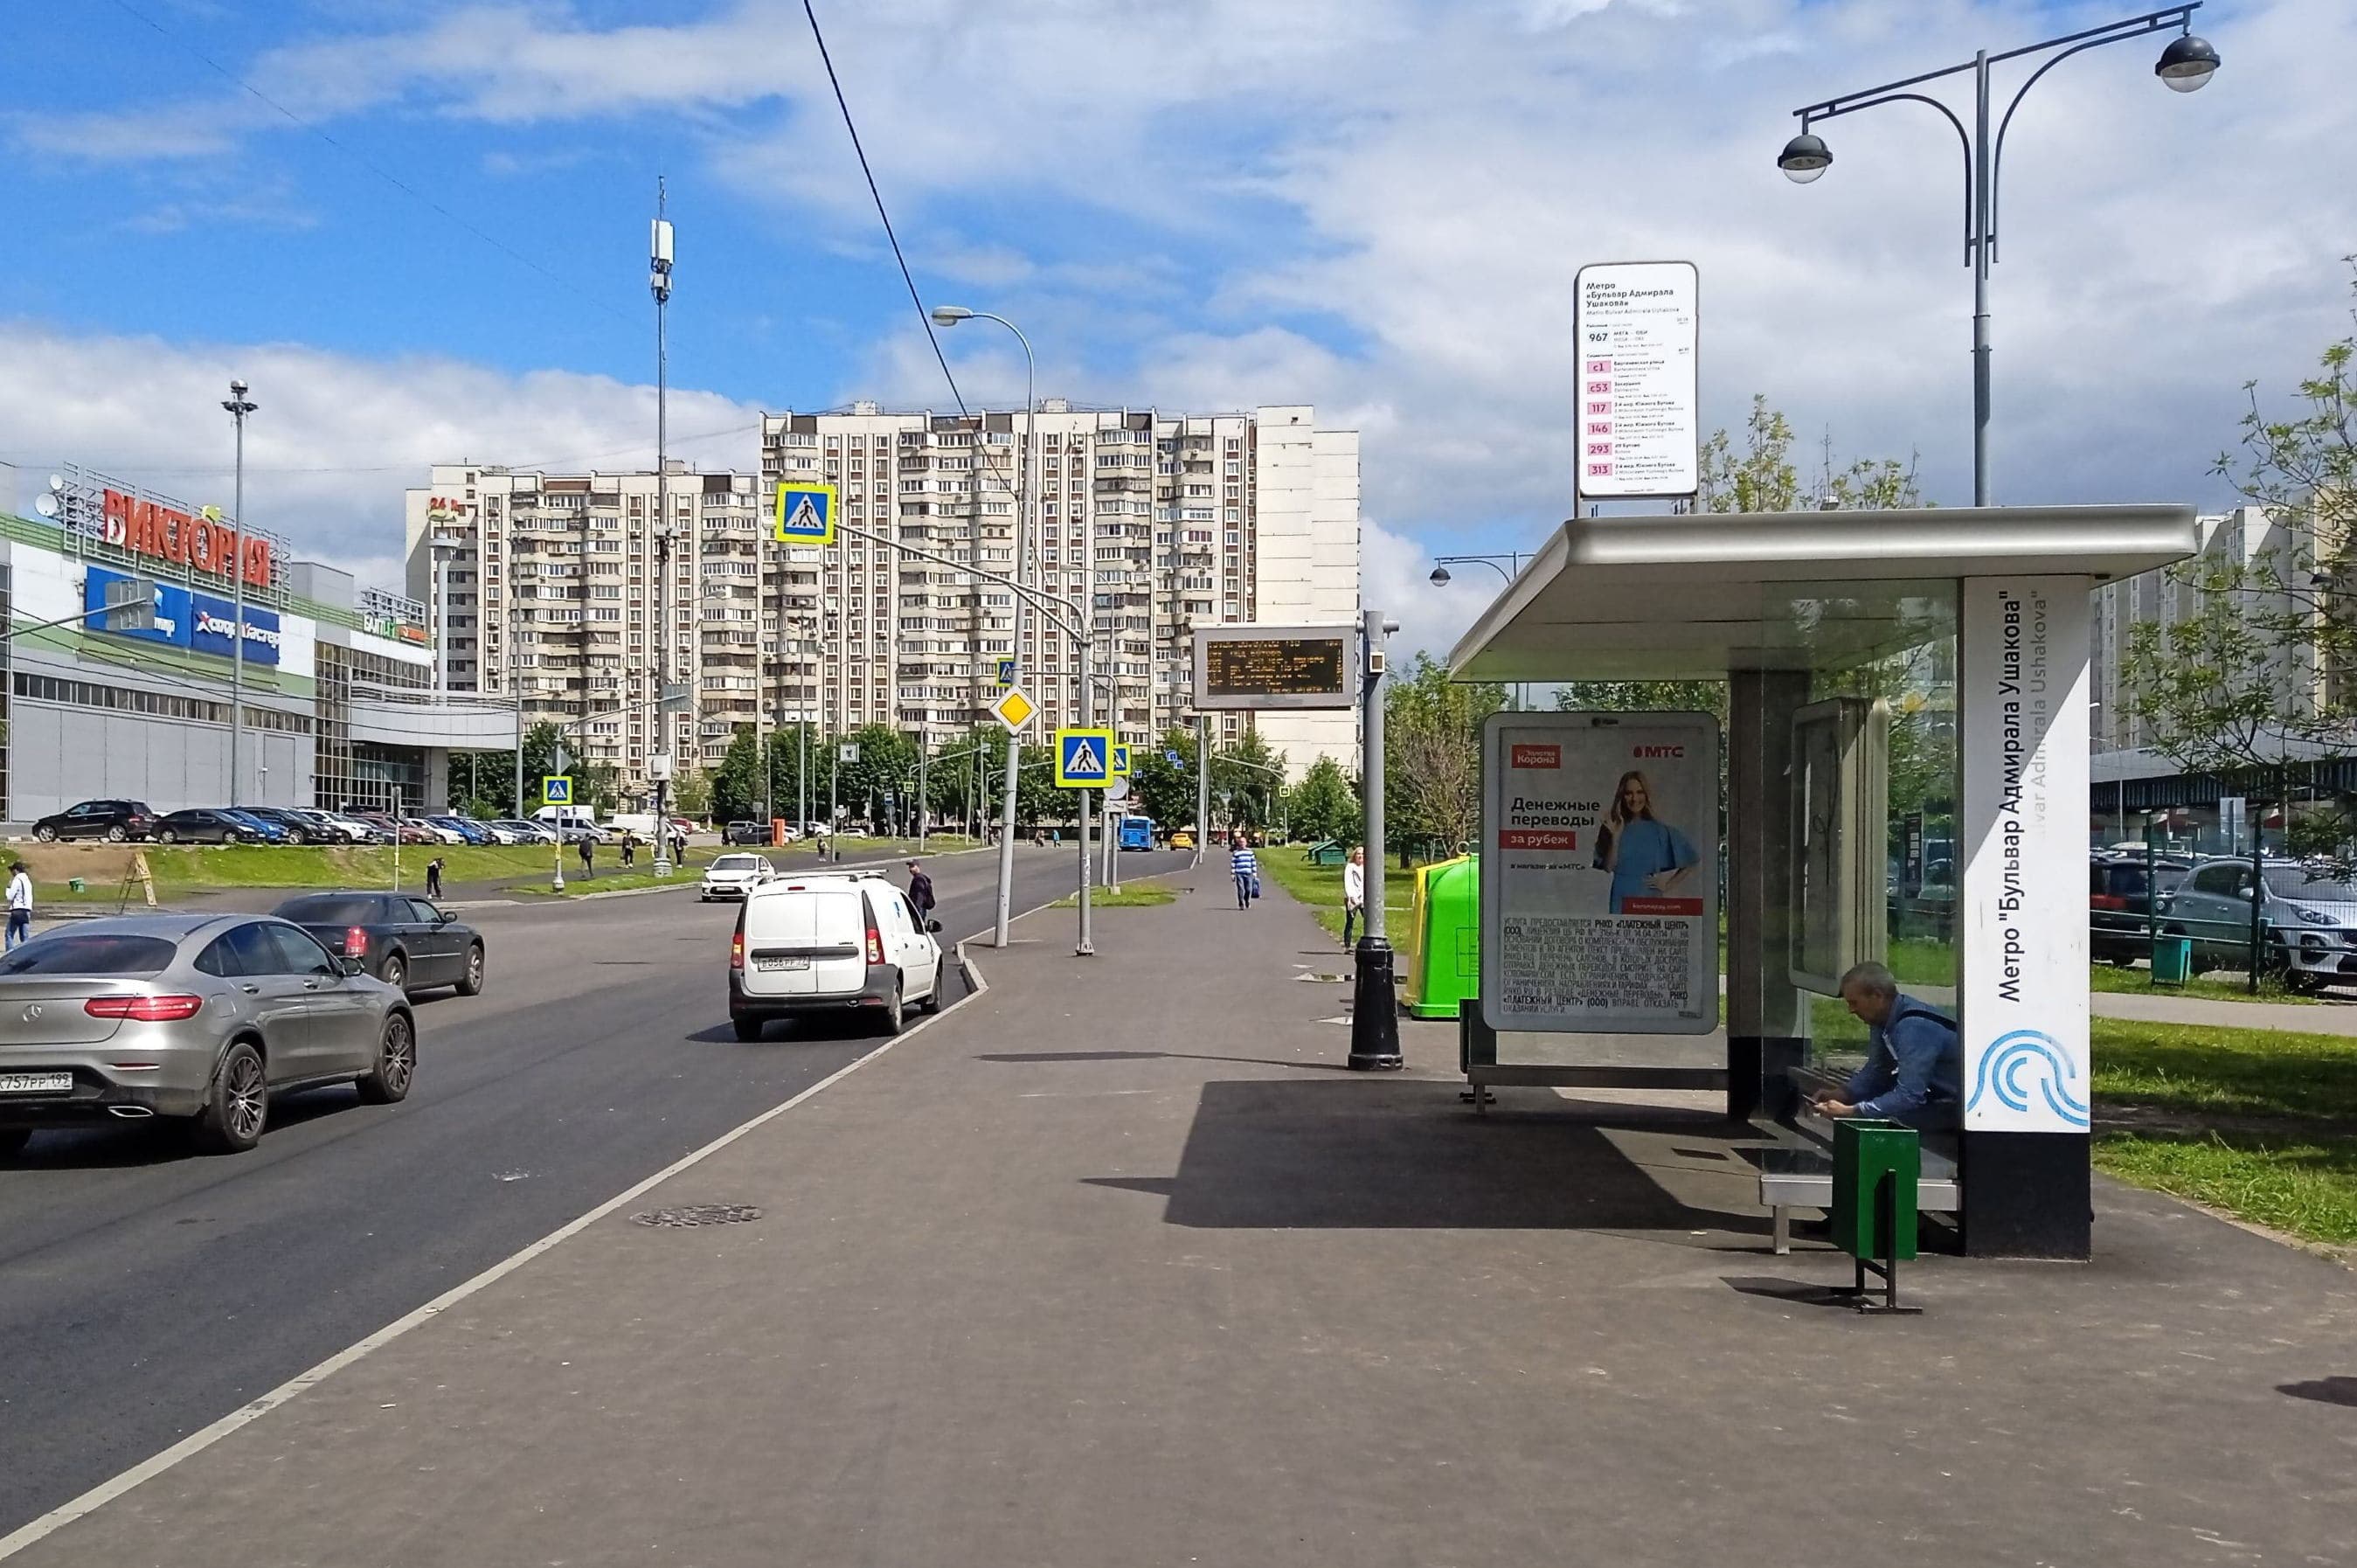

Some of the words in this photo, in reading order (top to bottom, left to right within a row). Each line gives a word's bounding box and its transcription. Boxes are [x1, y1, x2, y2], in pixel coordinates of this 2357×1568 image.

[1589, 332, 1608, 342] 967
[1591, 445, 1609, 454] 293
[1591, 465, 1608, 474] 313
[103, 489, 270, 587] ВИКТОРИЯ
[1998, 589, 2020, 694] Ушакова"
[2030, 589, 2047, 692] Ushakova"
[2031, 698, 2046, 787] Admirala
[1645, 746, 1684, 758] МТС
[1999, 701, 2023, 813] Адмирала
[1517, 754, 1556, 765] Корона
[1511, 797, 1601, 812] Денежные
[1511, 815, 1595, 828] переводы
[1528, 834, 1569, 846] рубеж
[1999, 819, 2024, 920] "Бульвар
[1999, 927, 2024, 1002] Метро
[1503, 996, 1552, 1005] «ПЛАТЕЖНЫЙ
[1556, 996, 1584, 1006] ЦЕНТР»
[1587, 997, 1608, 1007] (ООО)
[50, 1073, 69, 1084] 199
